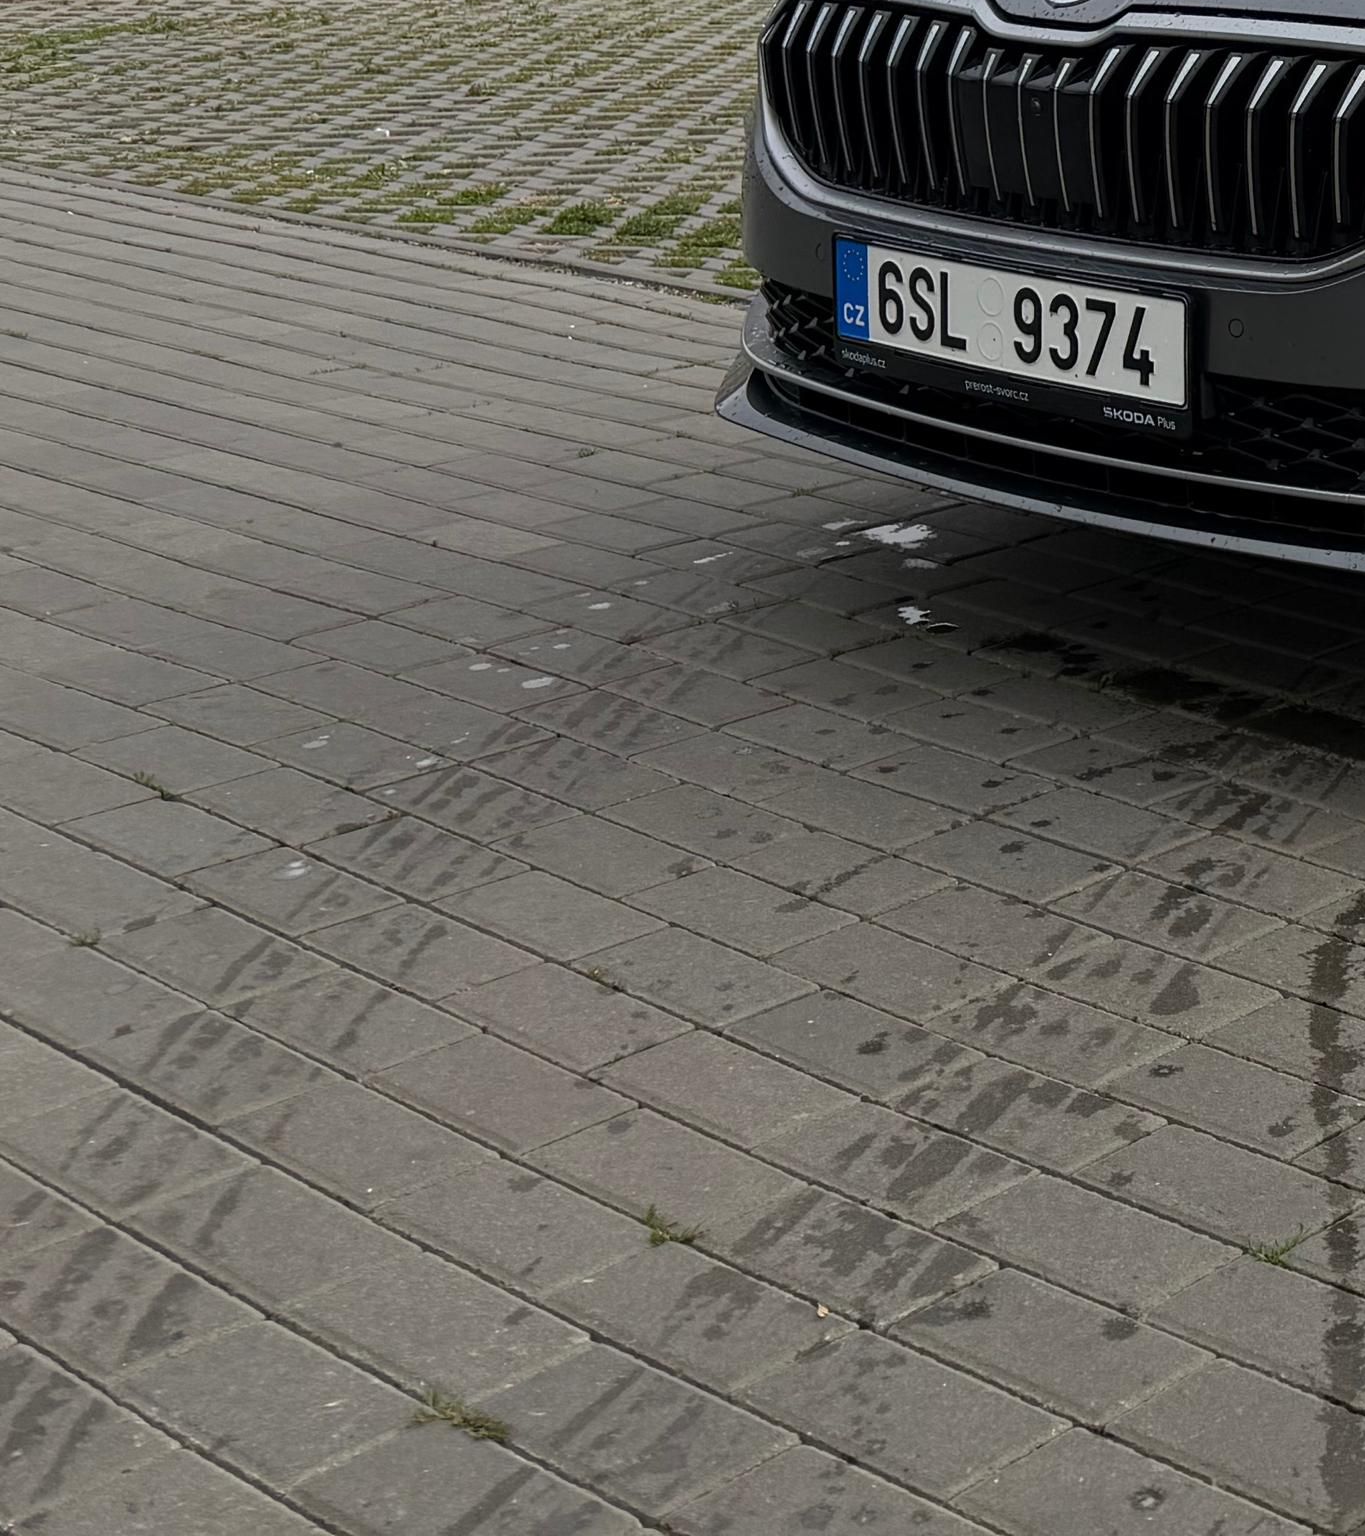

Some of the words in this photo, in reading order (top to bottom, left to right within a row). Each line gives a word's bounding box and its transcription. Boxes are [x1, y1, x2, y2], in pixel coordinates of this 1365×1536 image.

[843, 302, 865, 327] CZ
[878, 260, 967, 351] 6SL
[1013, 287, 1155, 387] 9374
[1157, 416, 1176, 431] Plus
